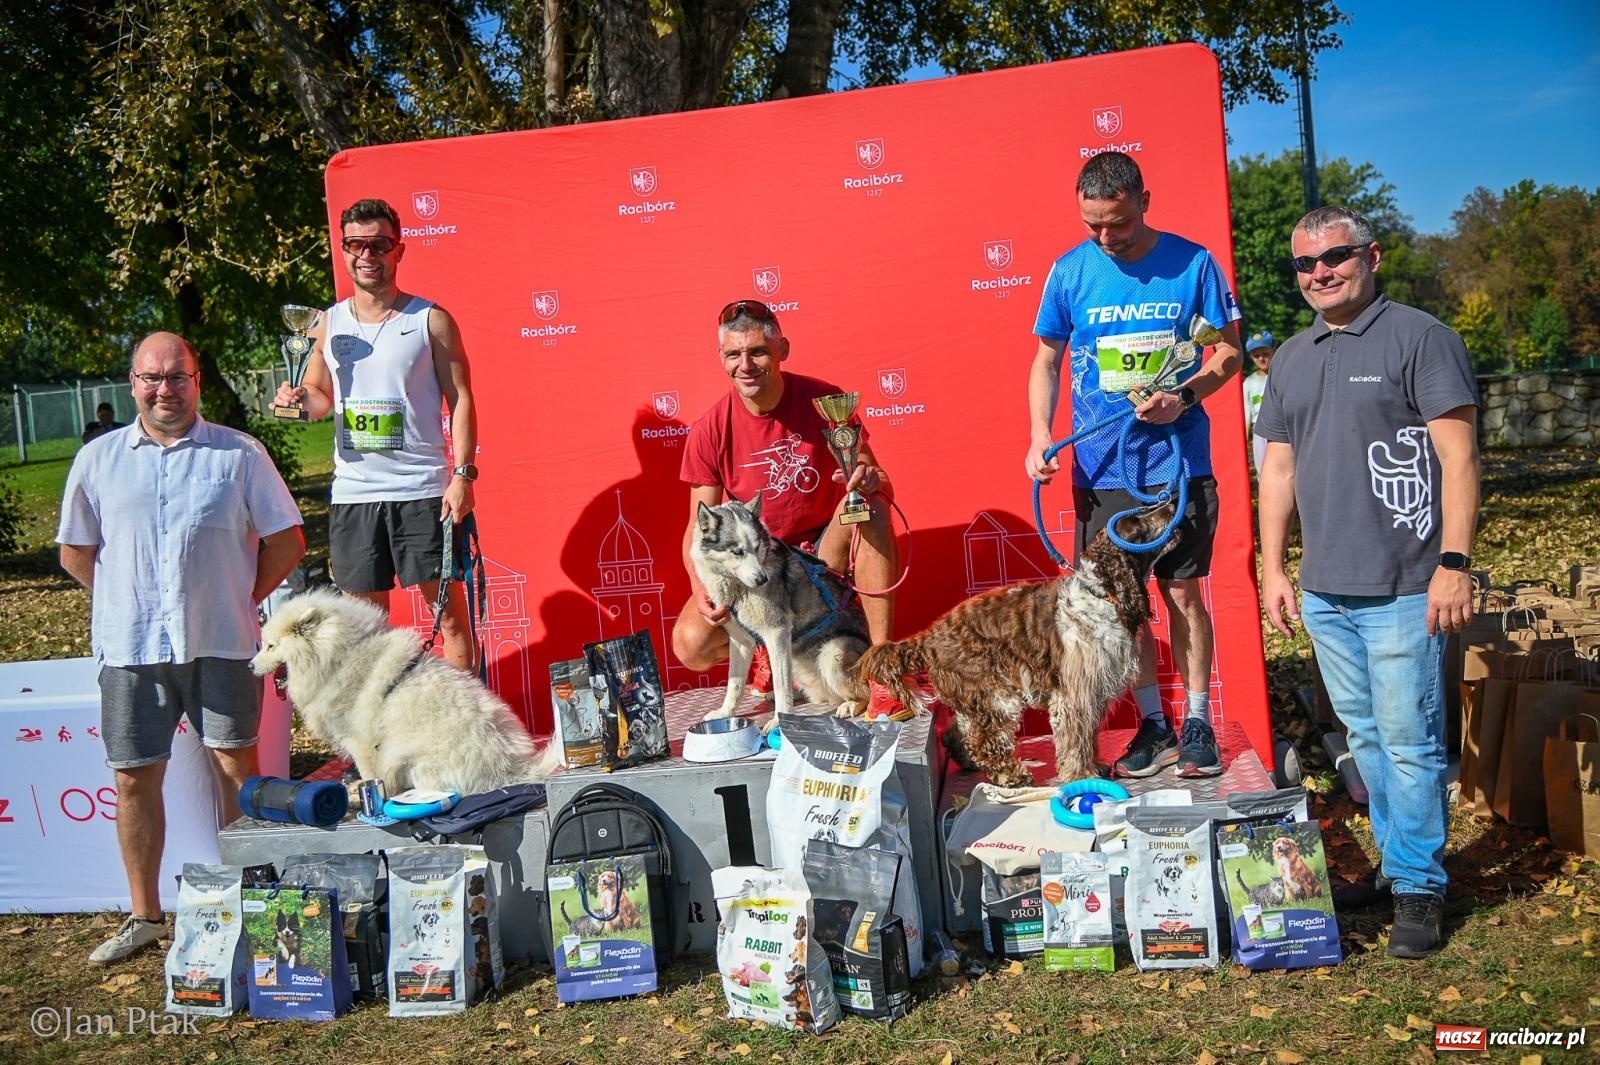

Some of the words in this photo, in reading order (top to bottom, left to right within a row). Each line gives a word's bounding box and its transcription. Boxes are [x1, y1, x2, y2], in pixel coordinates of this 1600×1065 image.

[843, 172, 904, 189] Racibórz
[866, 189, 882, 197] 1217
[618, 200, 676, 216] Racibórz
[640, 215, 656, 224] 1217
[401, 224, 457, 238] Racibórz
[971, 275, 1032, 291] Racibórz
[994, 291, 1010, 299] 1217
[766, 299, 799, 313] ibórz
[1086, 303, 1182, 325] TENNECO
[521, 323, 577, 338] Racibórz
[542, 338, 558, 347] 1217
[1121, 351, 1152, 372] 97
[1349, 375, 1382, 383] RACIBÓRZ
[866, 402, 925, 418] Racibórz
[355, 415, 379, 432] 81
[888, 418, 904, 427] 1217
[641, 425, 691, 439] Racibór
[814, 749, 864, 764] BIOFEED
[803, 778, 866, 803] EUPHORIA
[60, 787, 118, 822] OS
[805, 804, 840, 826] Fresh
[714, 784, 765, 867] 1
[973, 841, 1027, 853] Racibórz
[1149, 841, 1190, 850] EUPHORIA
[1152, 853, 1180, 864] Fresh
[410, 889, 448, 898] EUPHORIA
[1062, 884, 1092, 901] Mini
[412, 899, 437, 911] Fresh
[195, 908, 217, 919] Fresh
[1010, 908, 1036, 919] PRO
[1288, 917, 1326, 928] Flexodin
[604, 946, 640, 957] Flexodin
[744, 937, 783, 954] RABBIT
